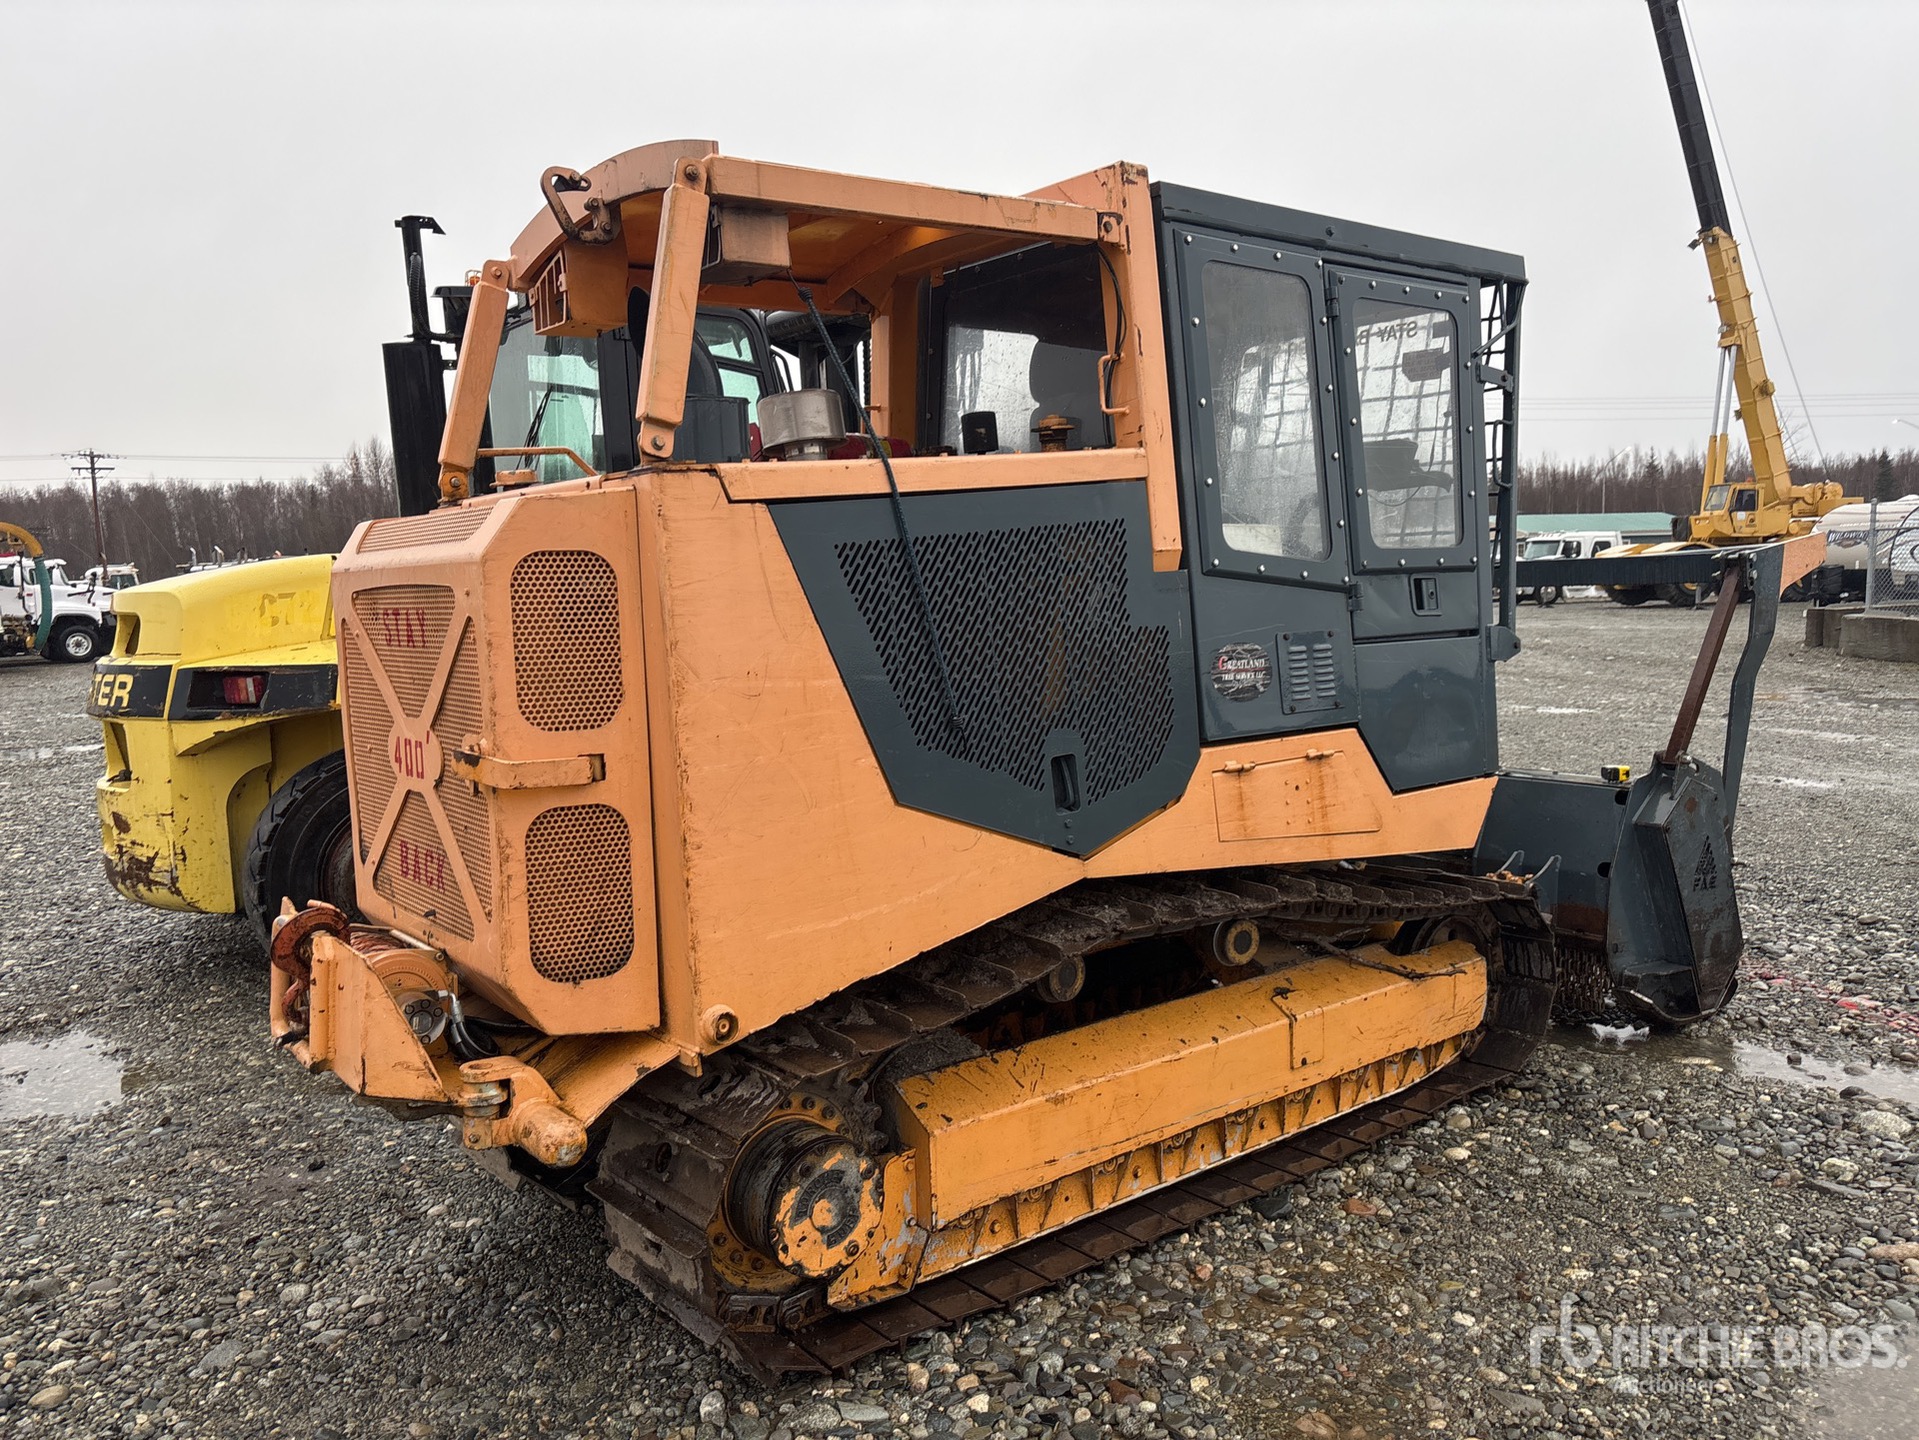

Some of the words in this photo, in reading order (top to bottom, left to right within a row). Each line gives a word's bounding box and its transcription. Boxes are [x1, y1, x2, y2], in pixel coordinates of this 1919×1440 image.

[383, 608, 427, 647] STAY
[1217, 655, 1265, 670] GREATLAND
[90, 673, 134, 707] TER
[400, 841, 447, 892] BACK
[1693, 876, 1718, 891] FAE
